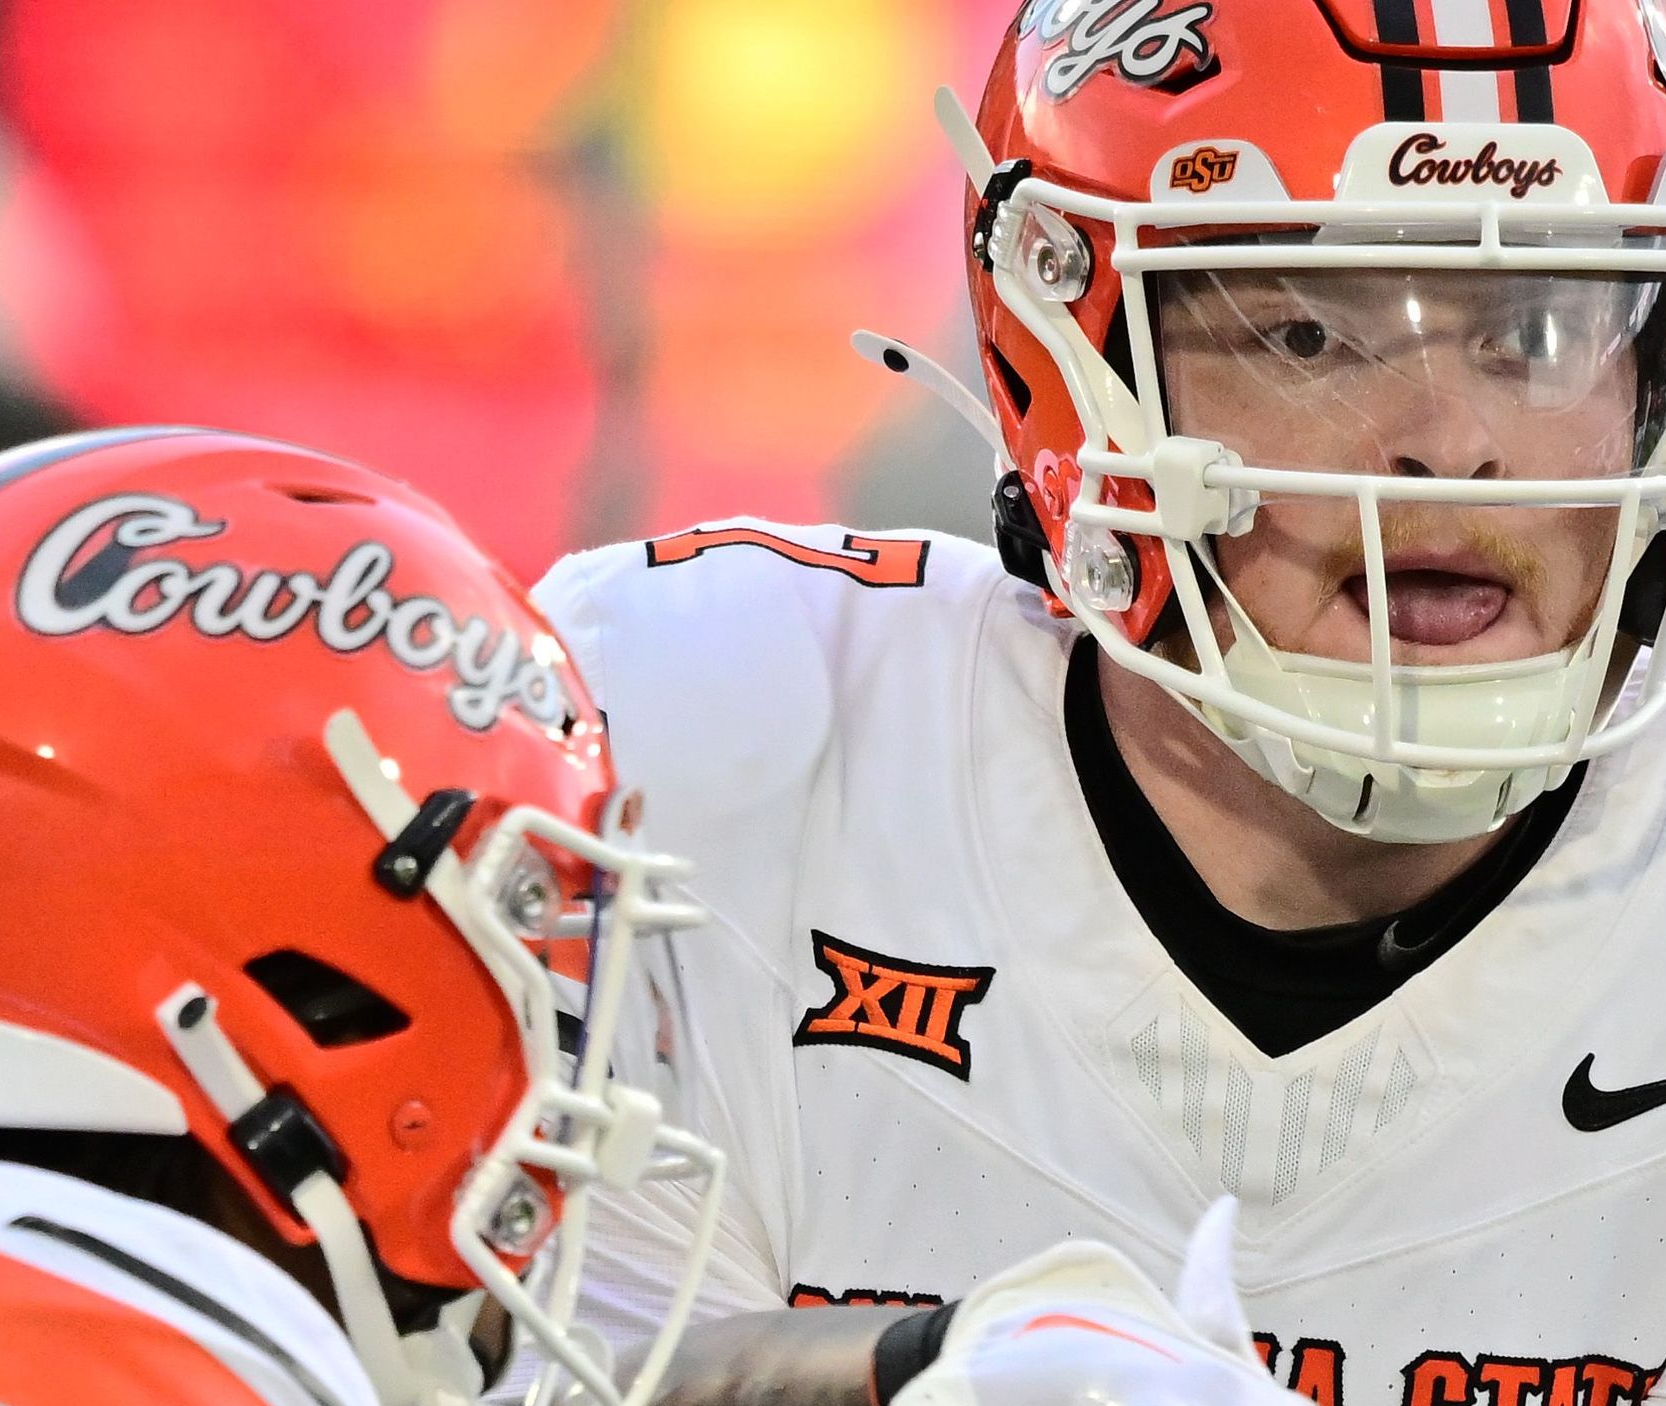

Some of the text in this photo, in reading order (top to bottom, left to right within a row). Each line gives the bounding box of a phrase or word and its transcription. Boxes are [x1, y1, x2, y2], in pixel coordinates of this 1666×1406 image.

[1169, 146, 1240, 194] OSU
[1388, 133, 1563, 198] Cowboys
[15, 492, 571, 732] Cowboys
[793, 930, 995, 1081] XII
